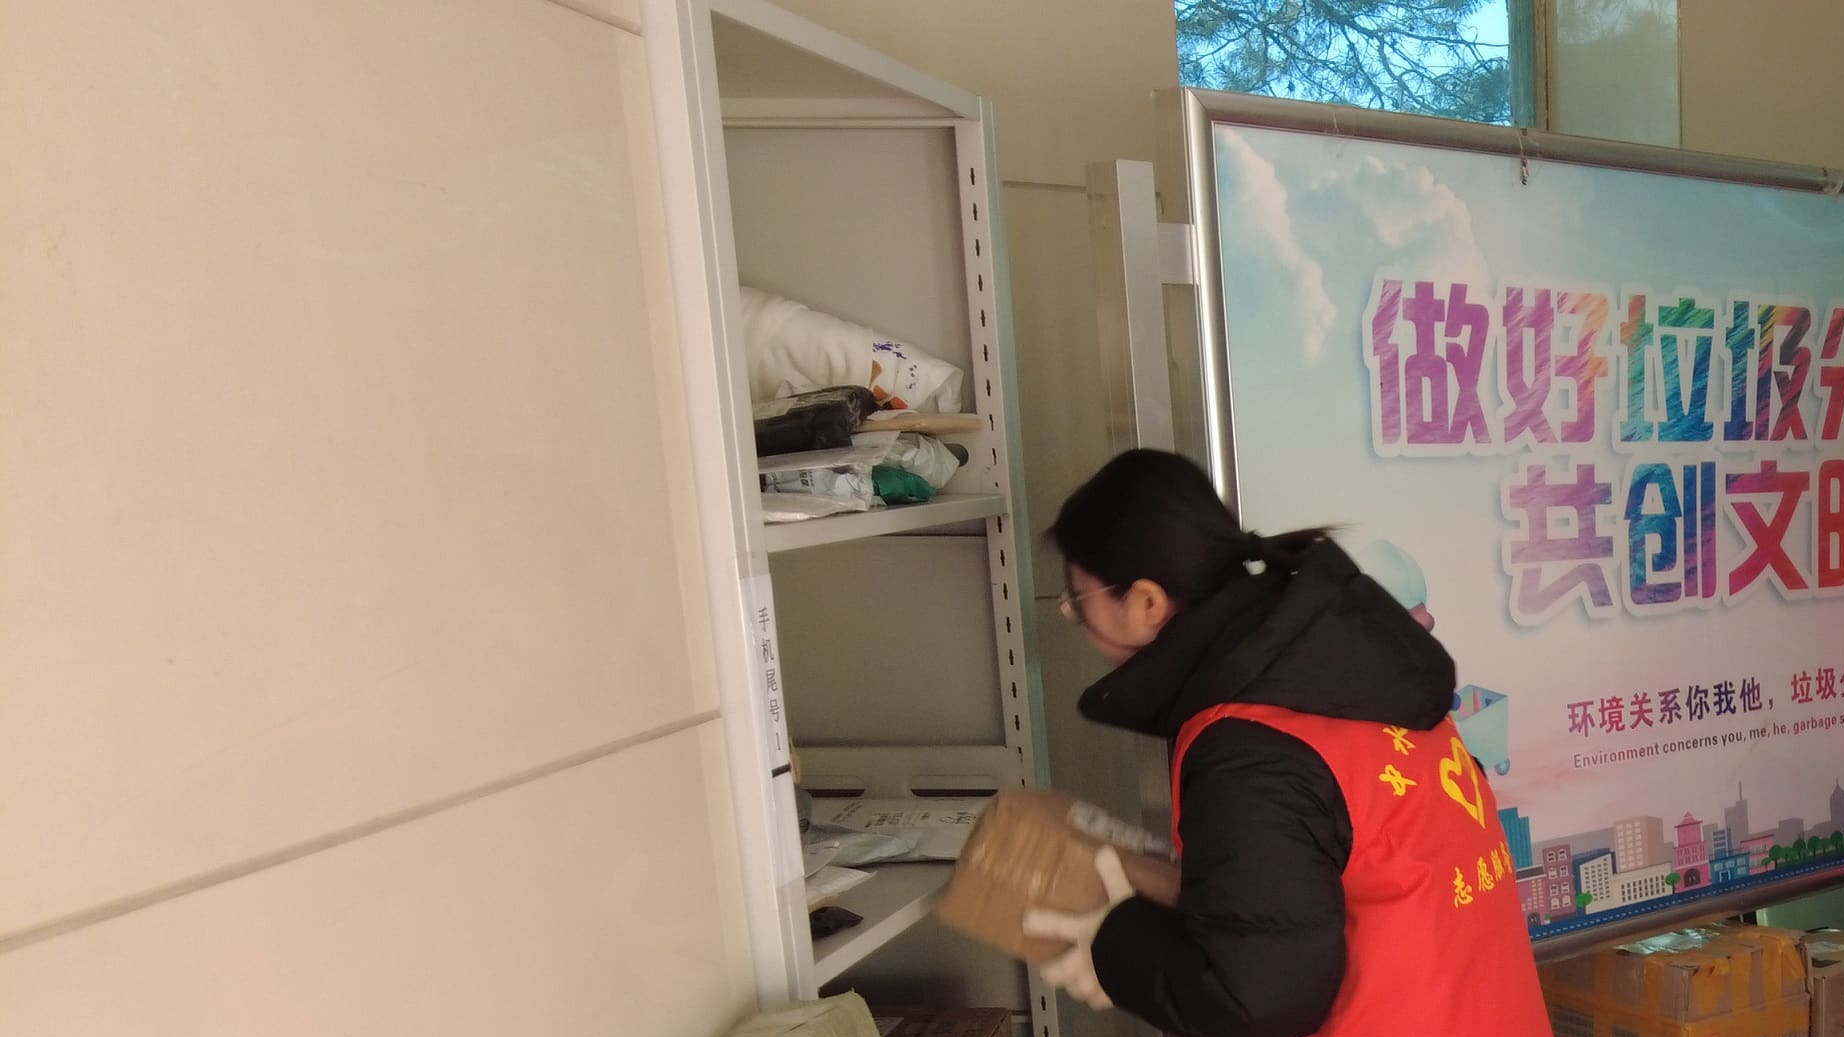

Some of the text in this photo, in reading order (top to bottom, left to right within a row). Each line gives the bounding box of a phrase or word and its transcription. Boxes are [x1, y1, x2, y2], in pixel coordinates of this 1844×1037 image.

[1573, 743, 1659, 769] Environment
[1662, 733, 1719, 755] concerns
[1721, 729, 1747, 753] you,
[1749, 725, 1769, 742] me,
[1772, 722, 1791, 738] he,
[1793, 713, 1838, 739] garbage
